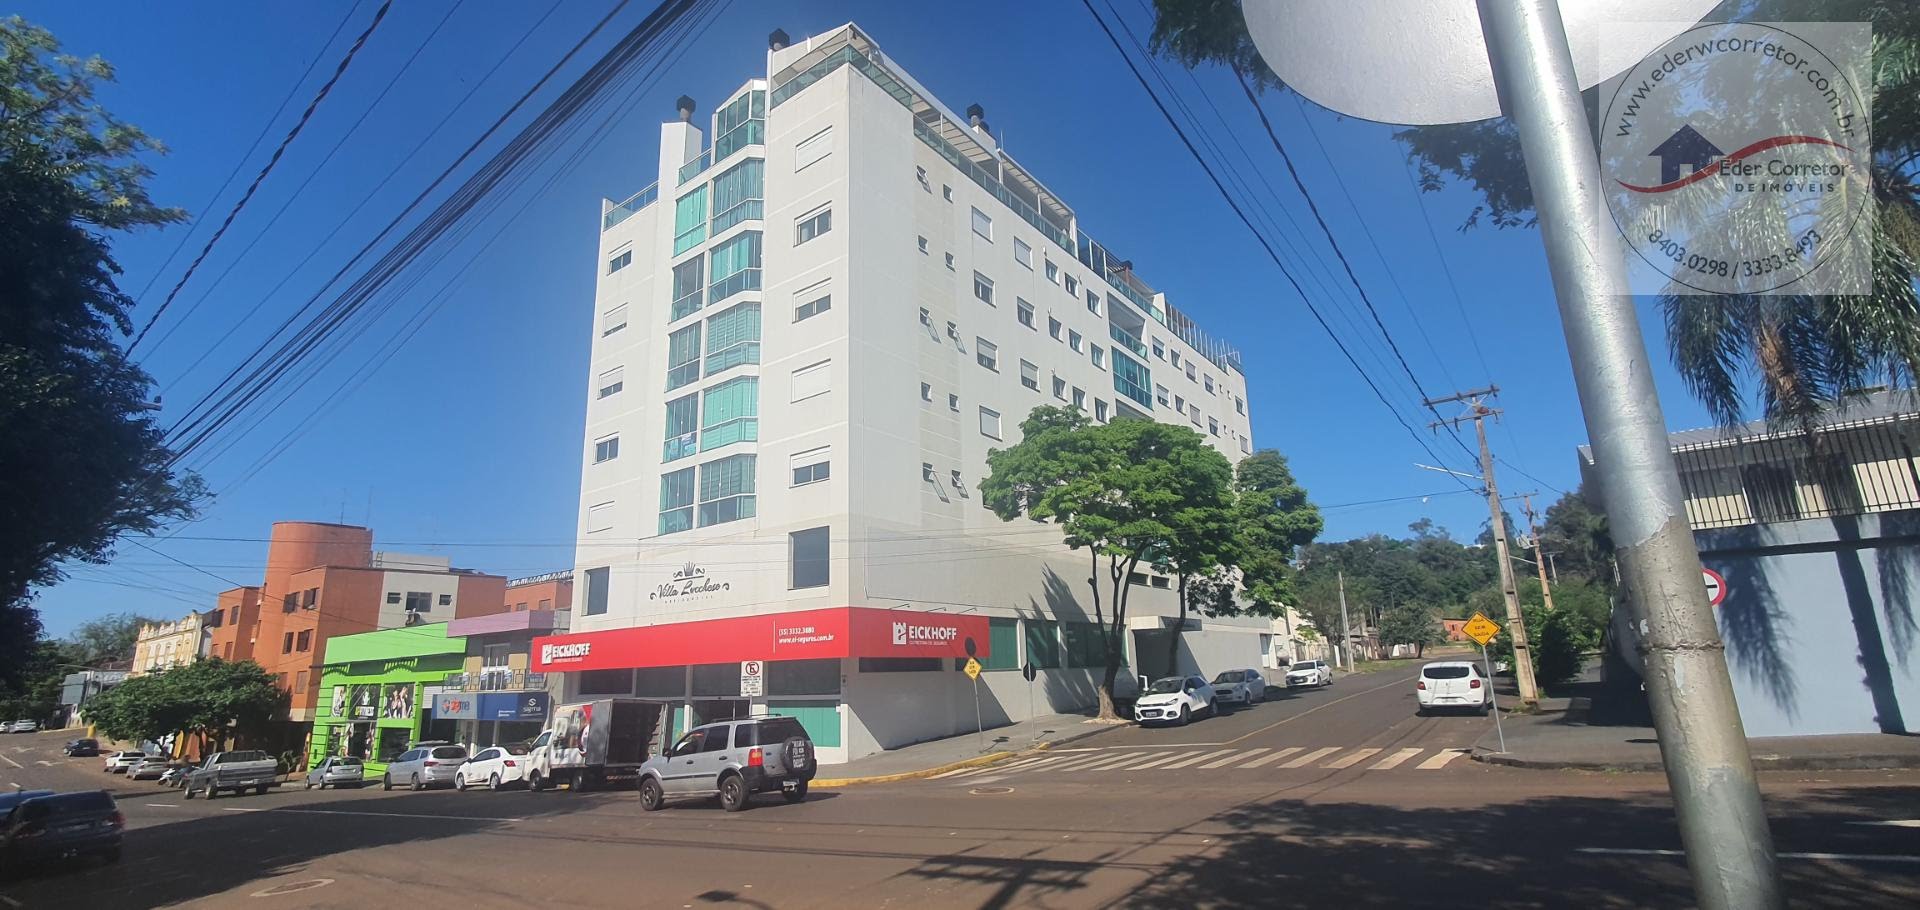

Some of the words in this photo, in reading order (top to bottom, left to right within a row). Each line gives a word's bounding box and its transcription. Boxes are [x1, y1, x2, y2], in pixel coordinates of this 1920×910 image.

[657, 583, 679, 599] Villa
[908, 625, 957, 640] EICKHOFF
[552, 643, 591, 659] EICKHOFF
